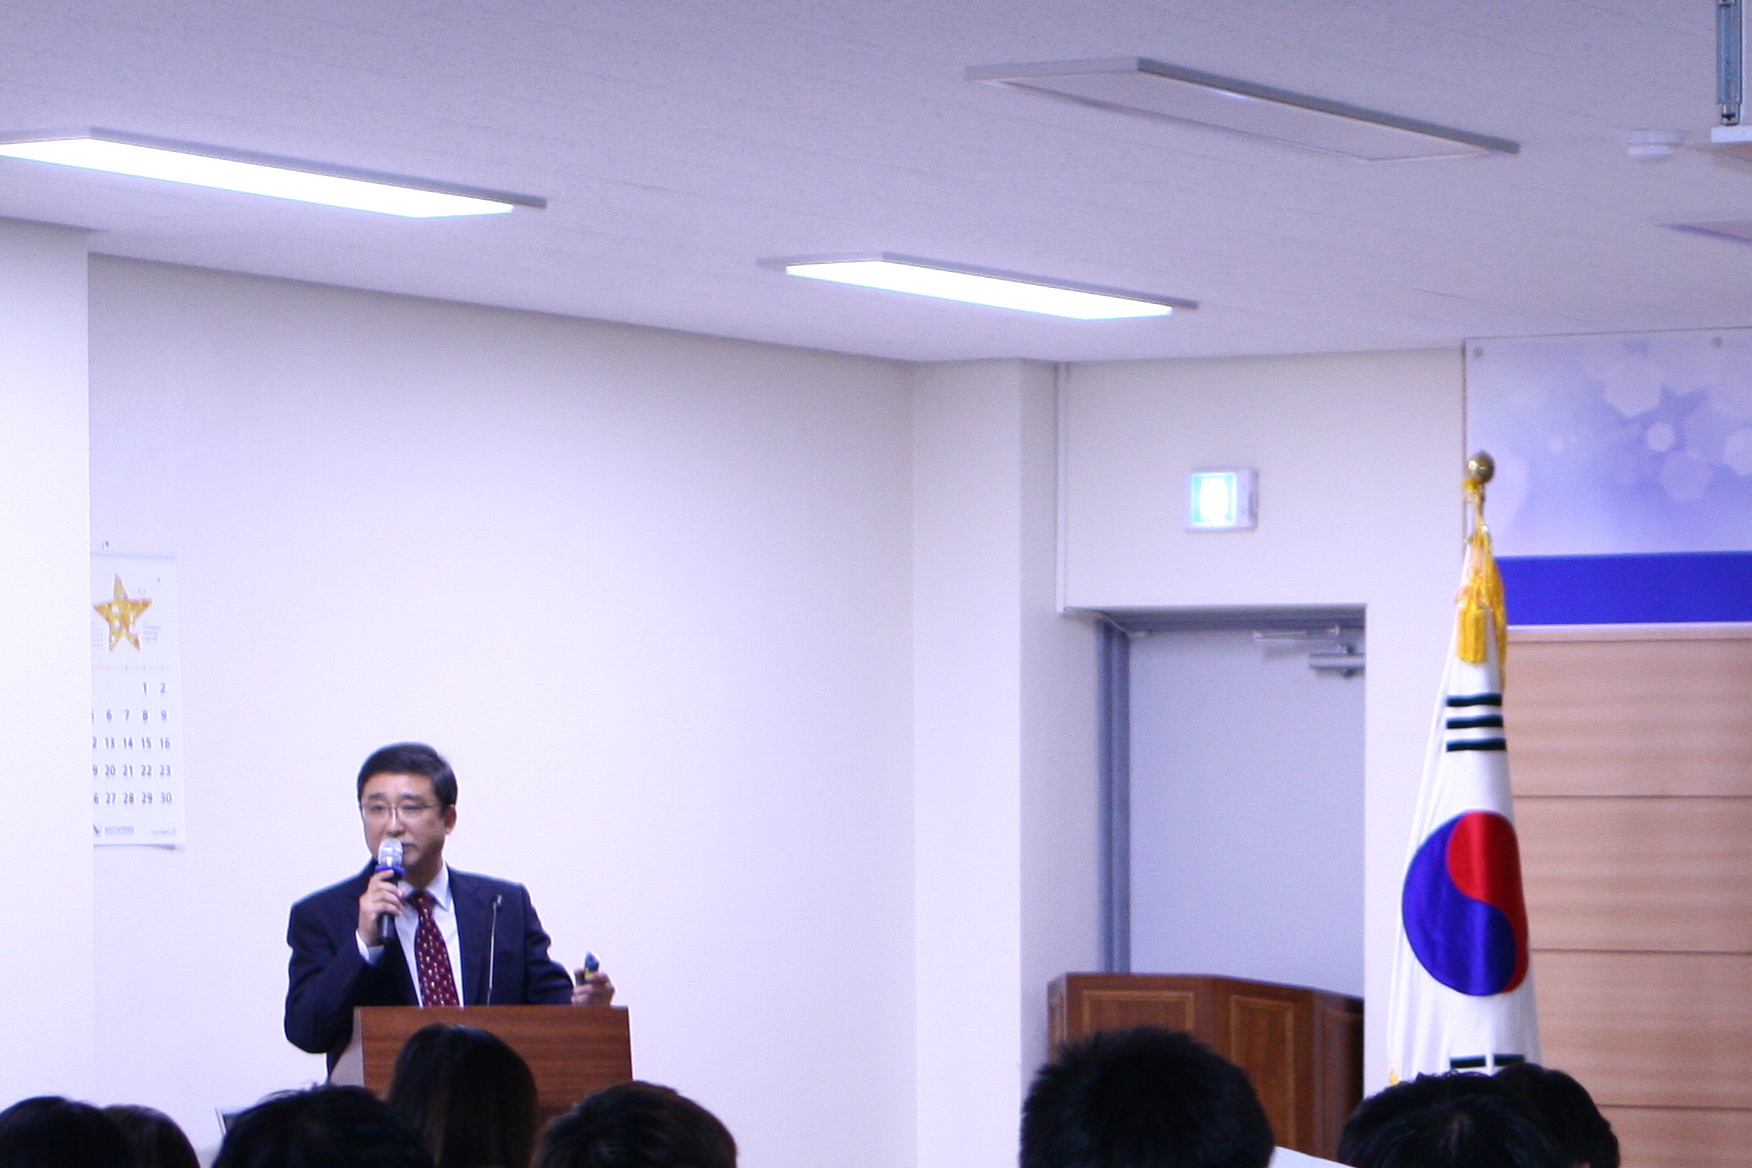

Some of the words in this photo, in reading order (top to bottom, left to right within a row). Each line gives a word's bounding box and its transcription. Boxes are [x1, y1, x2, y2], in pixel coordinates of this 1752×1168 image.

[105, 736, 116, 750] 13
[123, 736, 134, 750] 14
[141, 736, 152, 751] 15
[159, 736, 171, 750] 16
[104, 763, 117, 778] 20
[122, 763, 134, 778] 21
[140, 763, 152, 778] 22
[159, 763, 171, 778] 23
[105, 791, 117, 806] 27
[123, 791, 135, 806] 28
[141, 791, 154, 806] 29
[160, 791, 173, 806] 30
